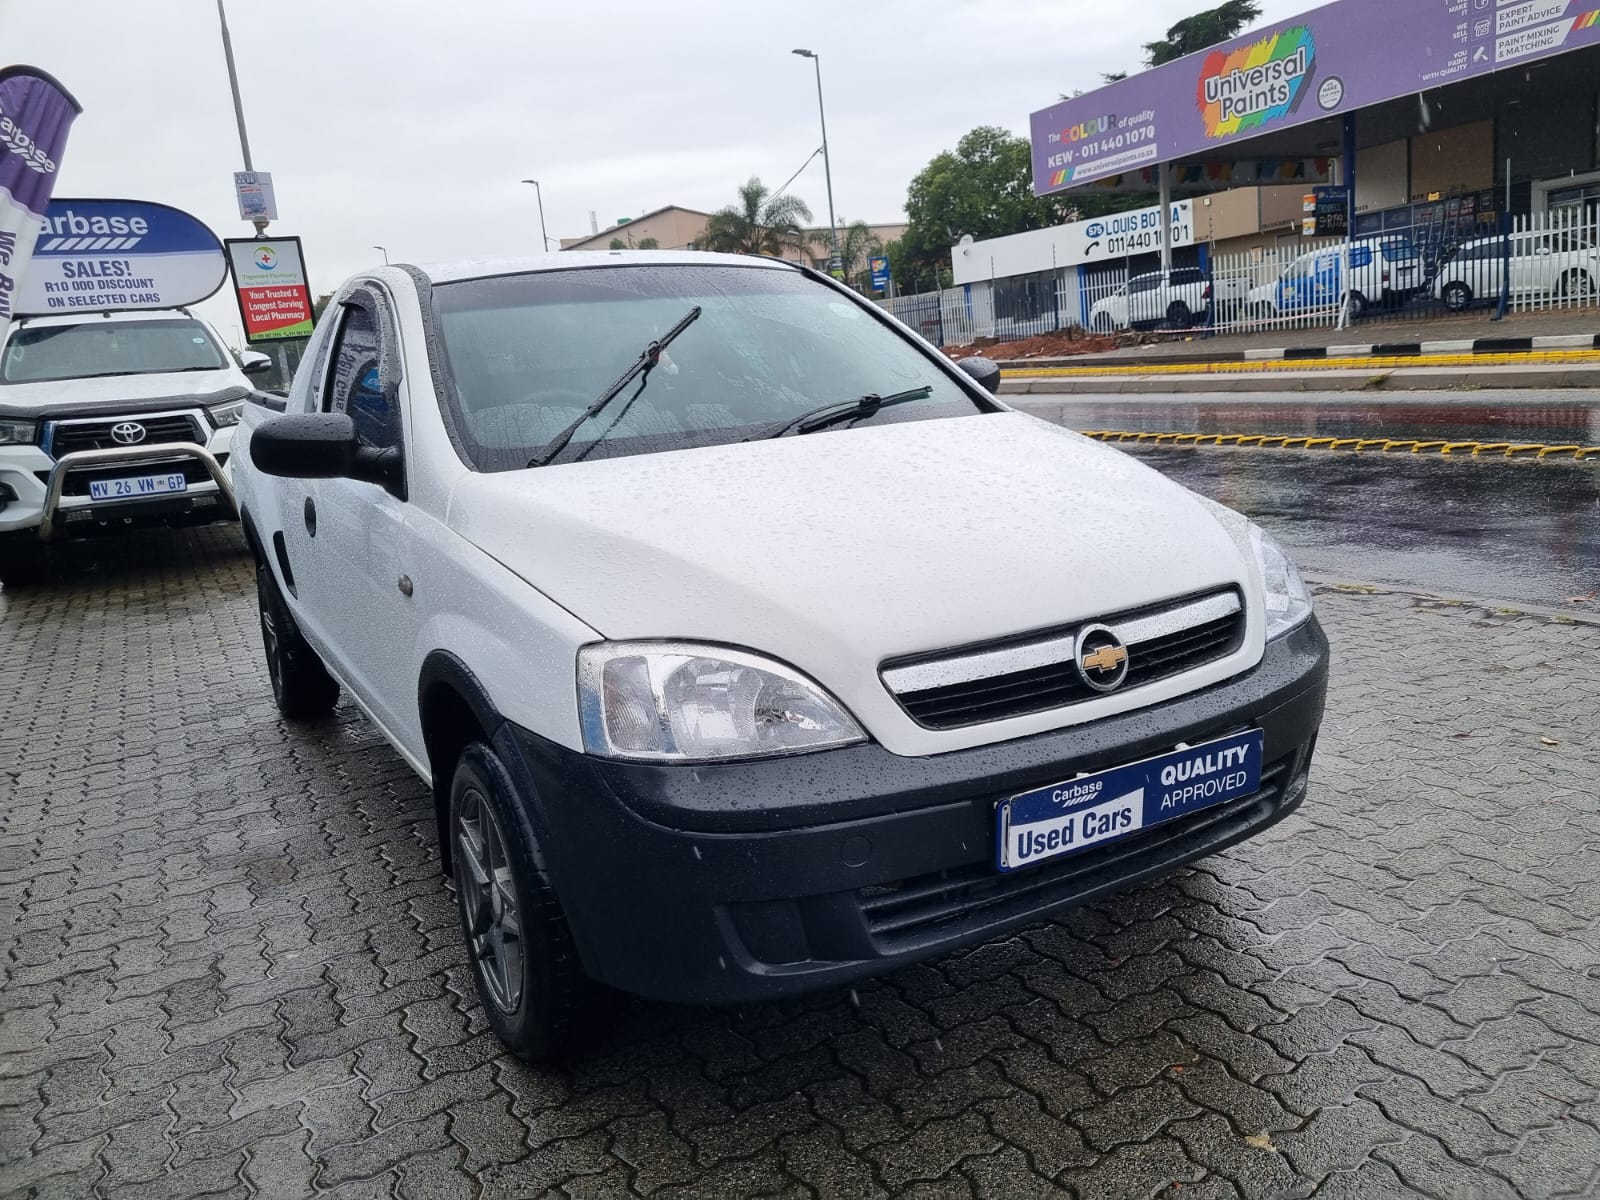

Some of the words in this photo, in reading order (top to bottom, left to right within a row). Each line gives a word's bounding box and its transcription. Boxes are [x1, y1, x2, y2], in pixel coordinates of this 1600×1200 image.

[1499, 16, 1527, 30] PAINT
[1527, 5, 1562, 21] ADVICE
[1500, 4, 1534, 21] EXPERT
[1456, 22, 1468, 31] WE
[1498, 34, 1527, 49] PAINT
[1527, 25, 1560, 41] MIXING
[1453, 50, 1468, 59] YOU
[1498, 50, 1504, 58] &
[1506, 37, 1554, 56] MATCHING
[1422, 71, 1440, 80] WITH
[1440, 64, 1468, 77] QUALITY
[1447, 56, 1468, 67] PAINT
[1205, 48, 1304, 102] Universal
[1221, 82, 1288, 119] Paints
[1048, 134, 1061, 144] The
[1061, 114, 1117, 145] COLOUR
[1118, 118, 1128, 129] of
[1127, 110, 1155, 126] quality
[0, 109, 56, 173] arbase
[1047, 150, 1073, 169] KEW
[1081, 142, 1099, 158] 011
[1101, 135, 1123, 152] 440
[39, 210, 149, 235] arbase
[1105, 215, 1138, 236] LOUIS
[1141, 207, 1180, 229] BOTA
[1108, 237, 1125, 253] 011
[1127, 232, 1151, 250] 440
[62, 260, 132, 278] SALES!
[44, 281, 69, 292] R10
[72, 280, 95, 291] 000
[98, 278, 155, 290] DISCOUNT
[248, 290, 265, 299] Your
[265, 289, 291, 298] Trusted
[292, 288, 299, 297] &
[47, 297, 65, 308] ON
[67, 294, 127, 307] SELECTED
[130, 292, 160, 304] CARS
[248, 301, 277, 311] Longest
[278, 300, 304, 309] Serving
[251, 312, 270, 321] Local
[271, 311, 305, 320] Pharmacy
[92, 483, 108, 497] MV
[115, 481, 131, 494] 26
[138, 478, 155, 491] VN
[168, 475, 184, 489] GP
[1160, 743, 1249, 786] QUALITY
[1052, 780, 1103, 803] Carbase
[1160, 771, 1248, 811] APPROVED
[1017, 811, 1074, 859] Used
[1082, 806, 1132, 840] Cars
